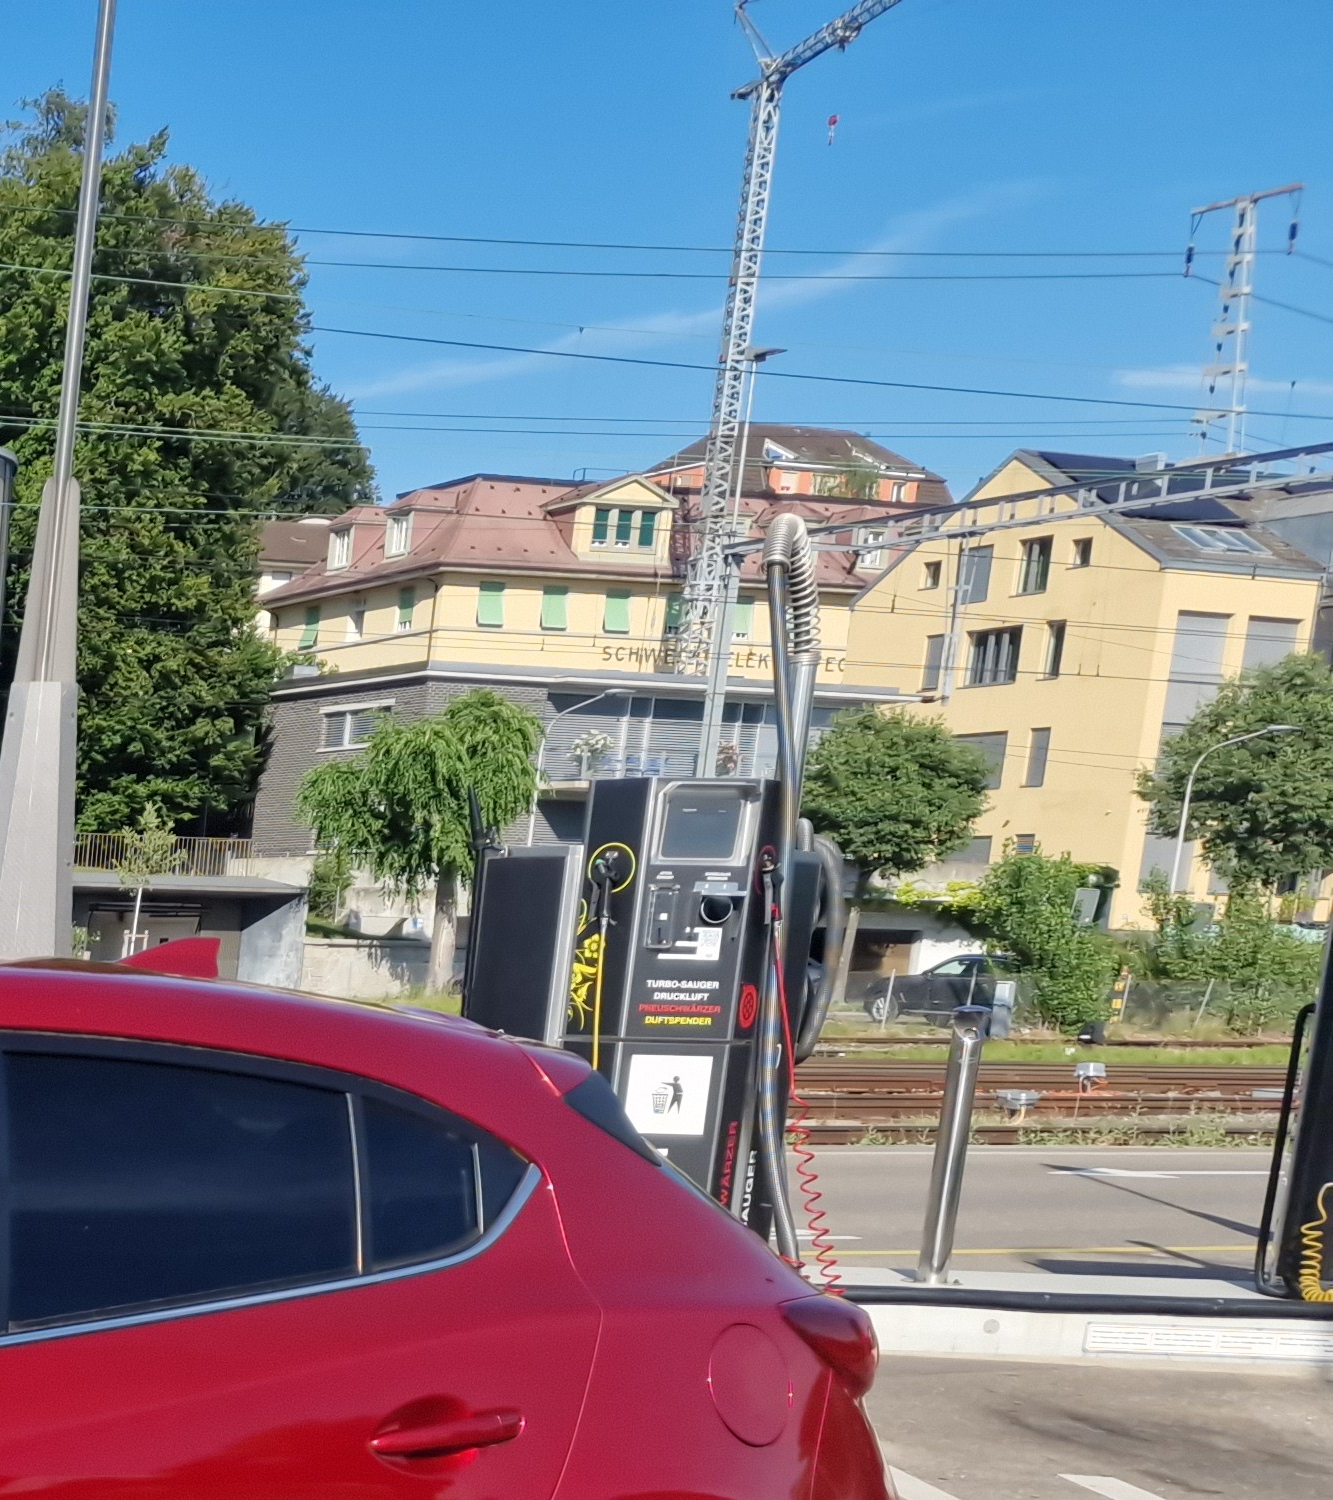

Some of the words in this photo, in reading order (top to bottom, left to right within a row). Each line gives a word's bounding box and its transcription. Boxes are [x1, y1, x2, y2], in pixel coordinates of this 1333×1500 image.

[646, 979, 720, 990] TURBO-SAUGER
[653, 991, 710, 1001] DRUCKLUFT
[645, 1015, 712, 1026] DUFTSPENDER
